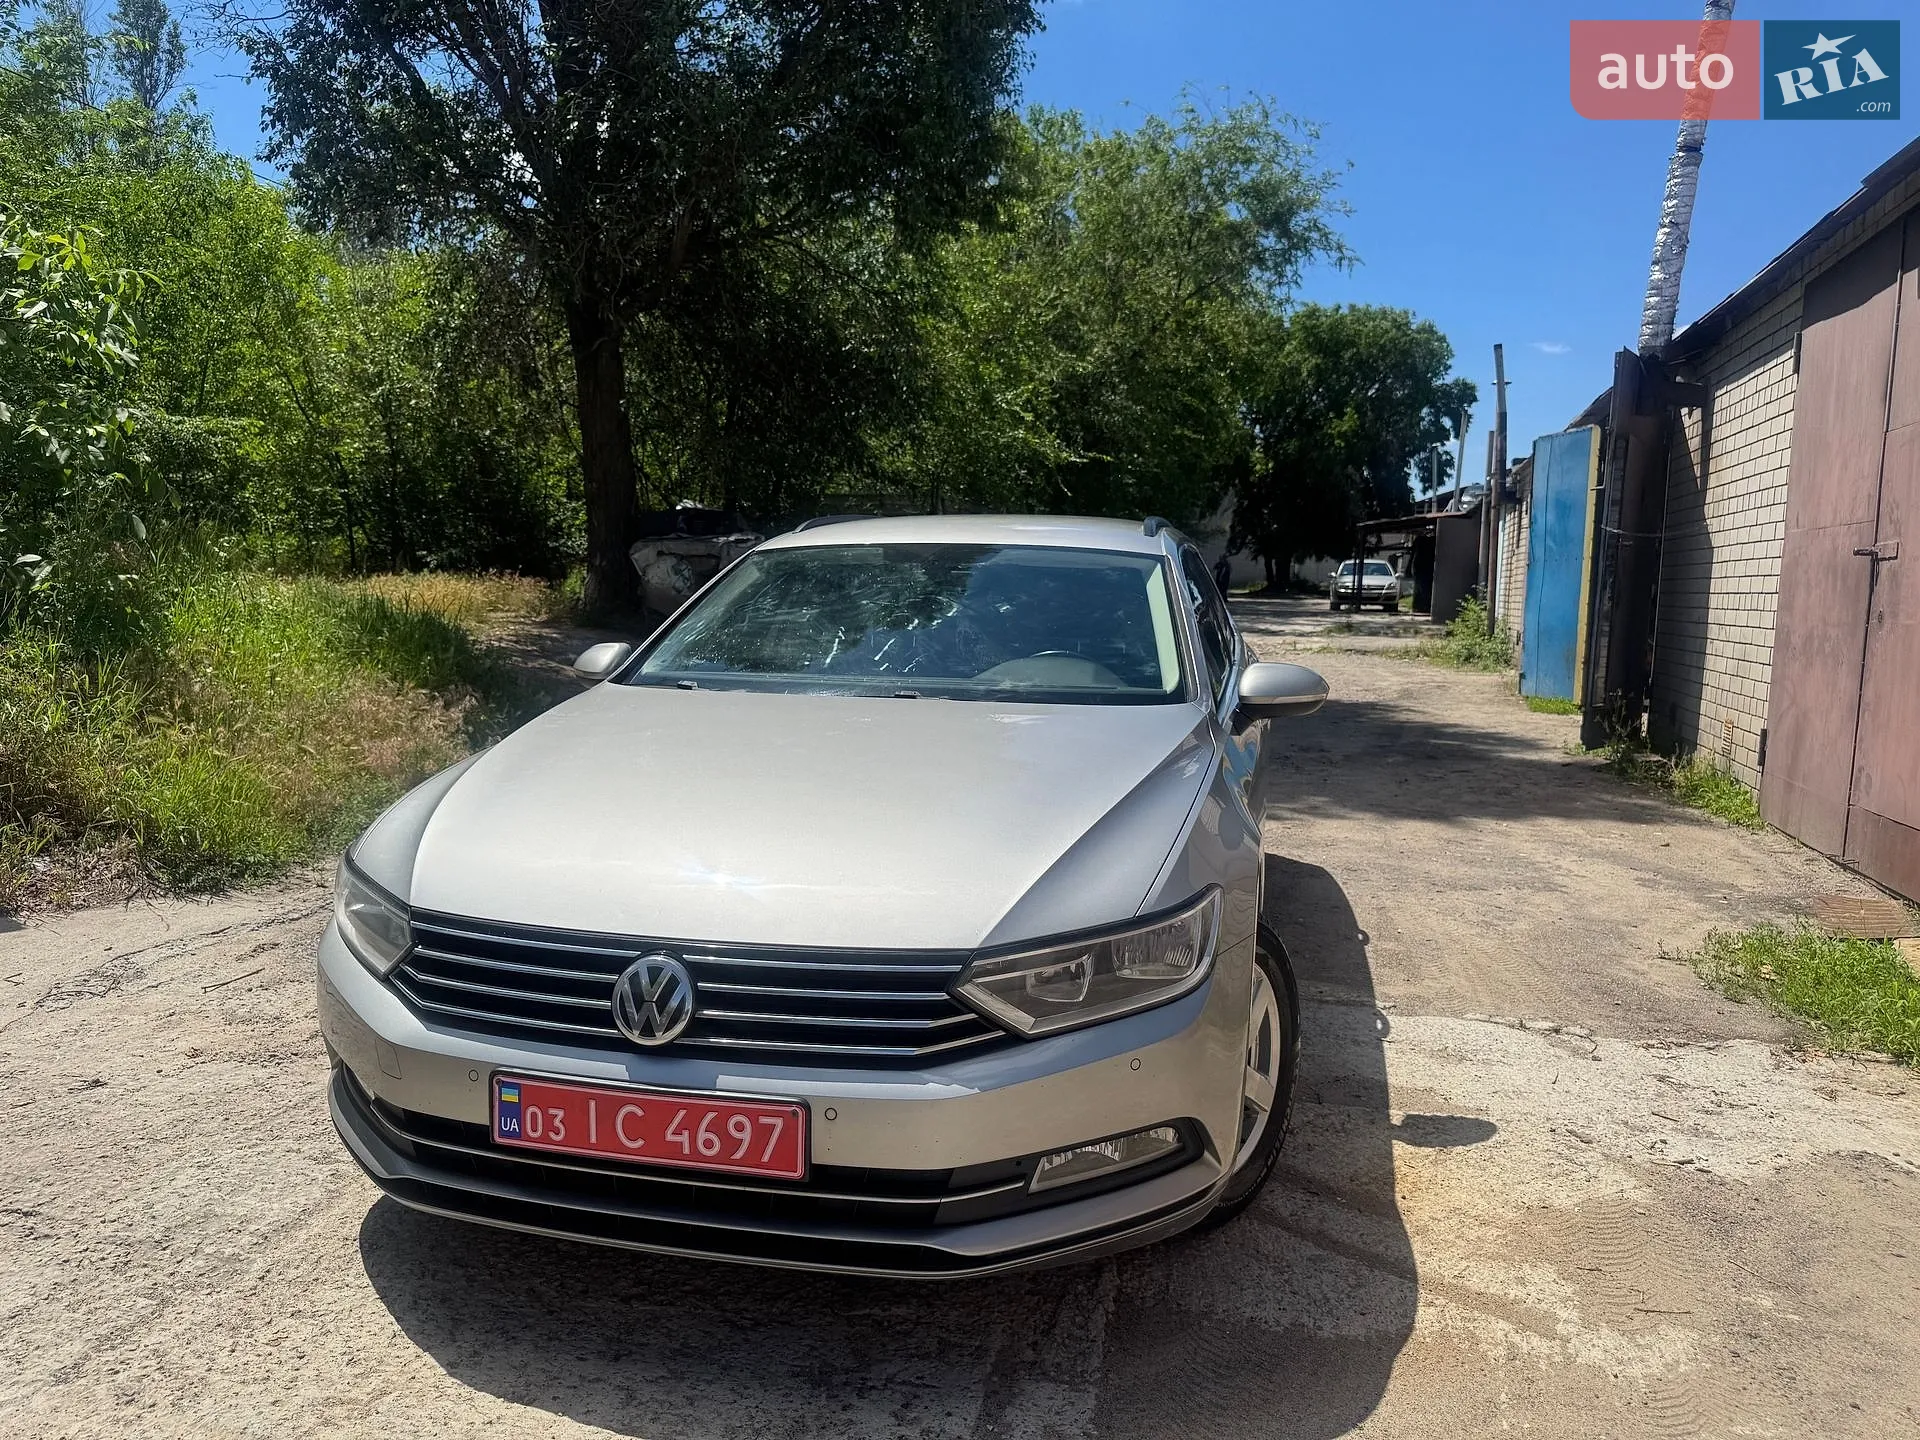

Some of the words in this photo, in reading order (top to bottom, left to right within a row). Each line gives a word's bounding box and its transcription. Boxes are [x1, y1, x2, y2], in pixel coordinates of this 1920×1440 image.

[501, 1116, 520, 1133] UA
[525, 1105, 566, 1142] 03
[664, 1109, 784, 1163] 4697
